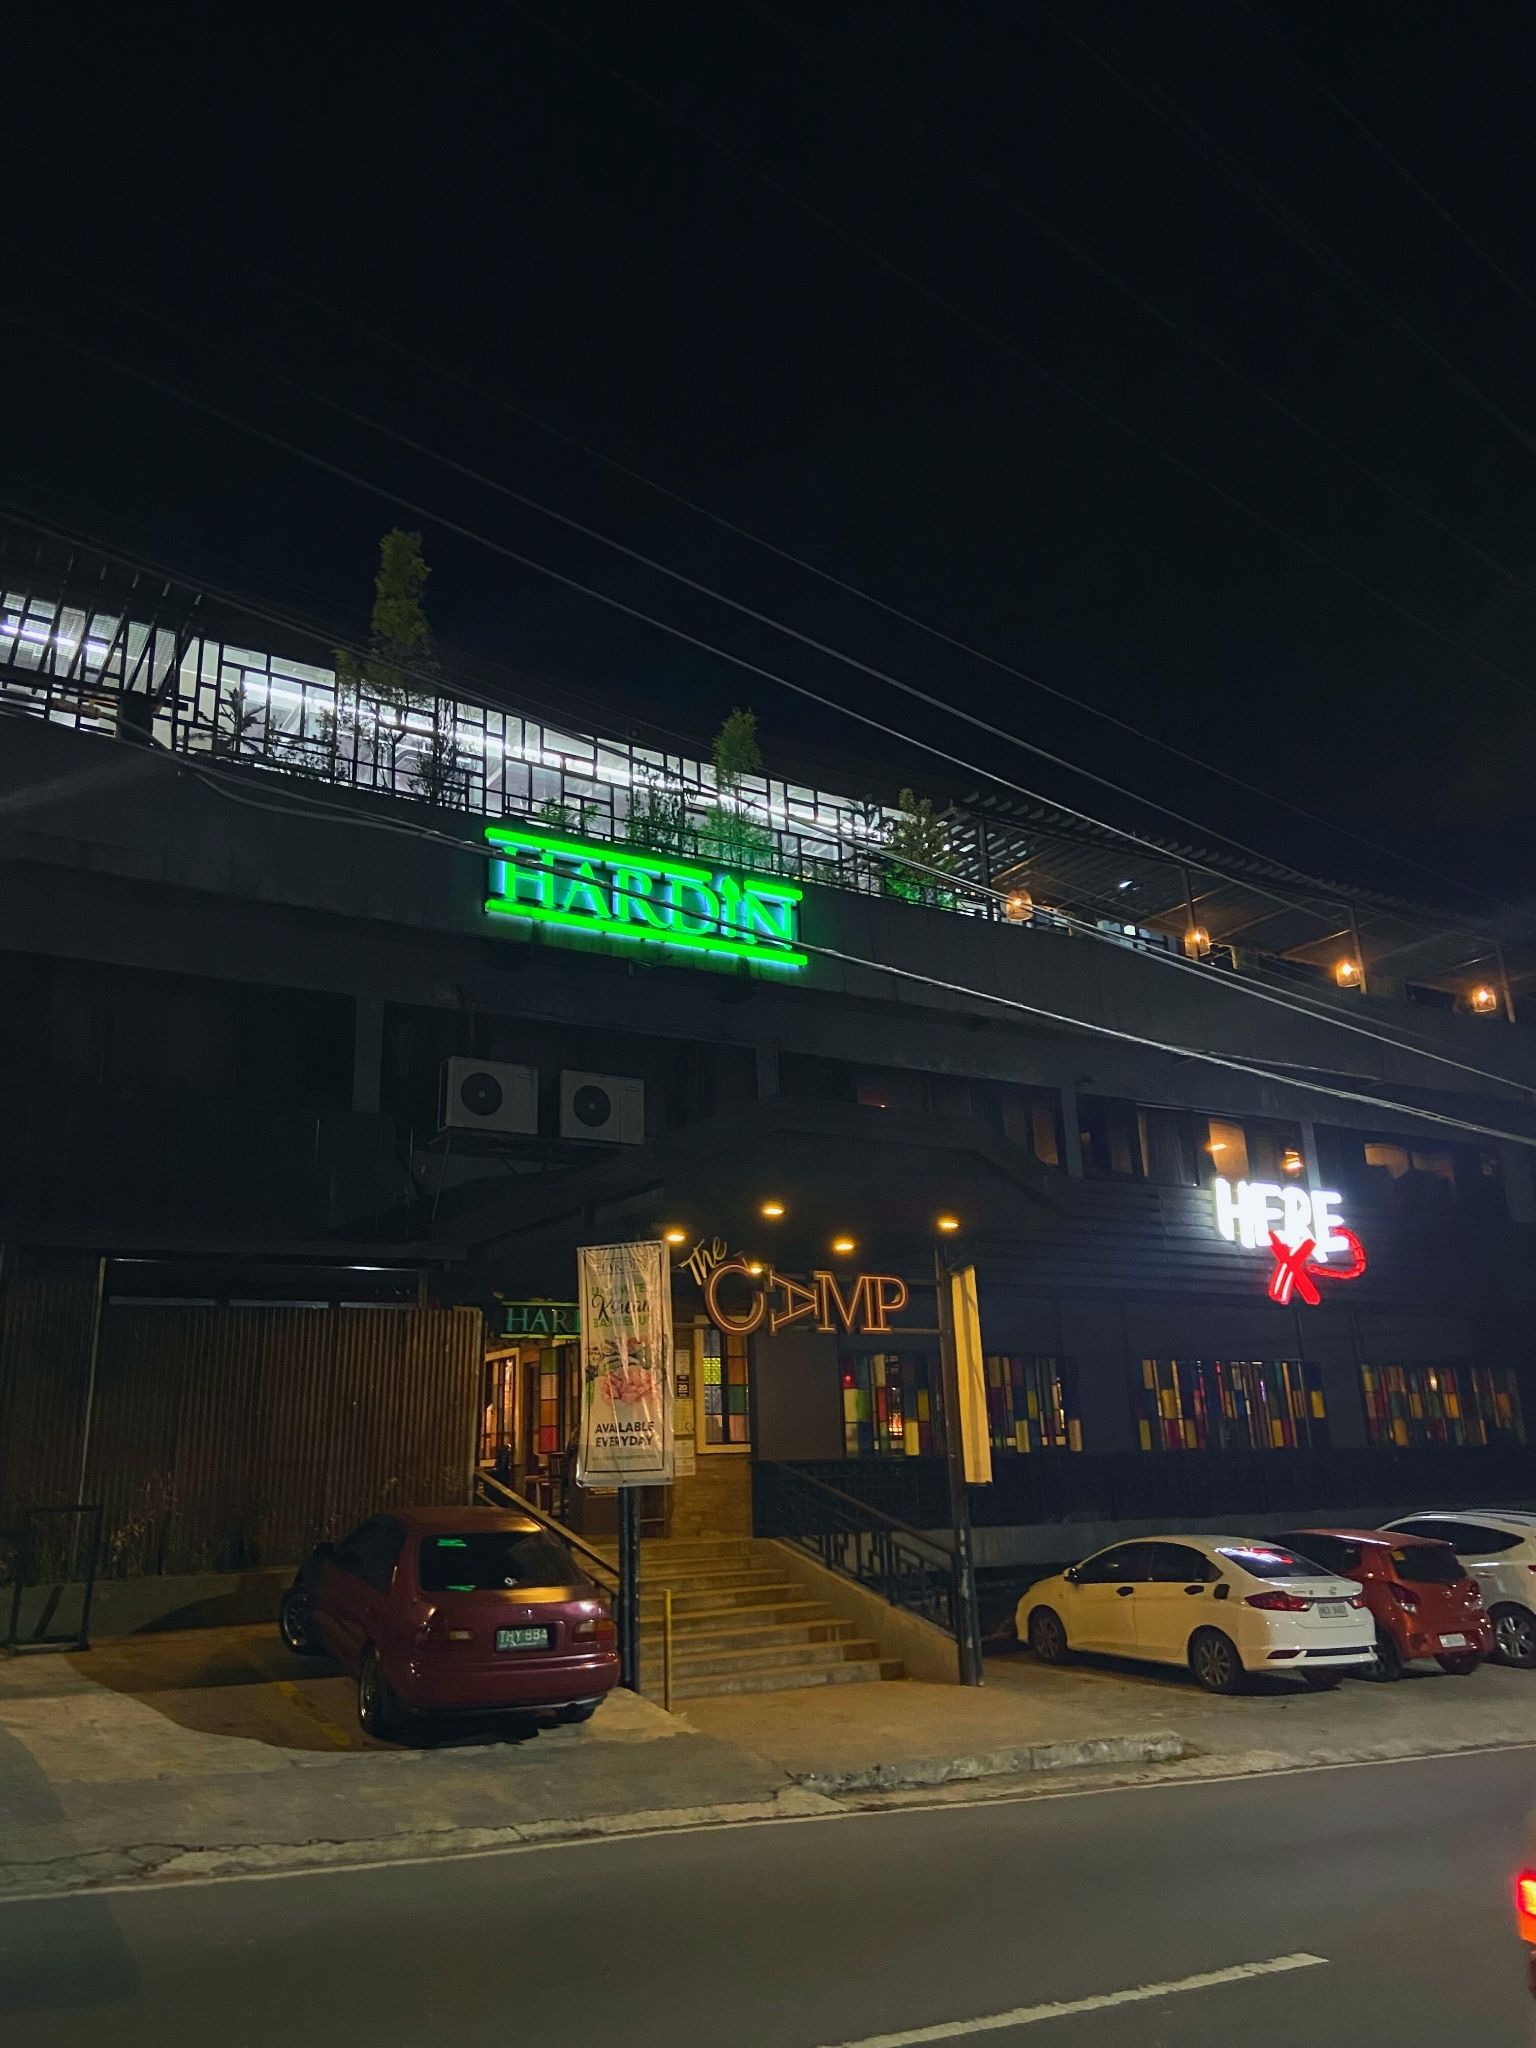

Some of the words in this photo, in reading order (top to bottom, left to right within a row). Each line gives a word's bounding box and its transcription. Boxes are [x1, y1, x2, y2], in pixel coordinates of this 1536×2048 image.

[502, 845, 793, 951] HARDIN
[1214, 1177, 1350, 1263] HERE
[678, 1236, 727, 1286] The
[704, 1261, 908, 1336] CAMP
[595, 1421, 655, 1434] AVAILABLE
[595, 1434, 653, 1447] EVERYDAY
